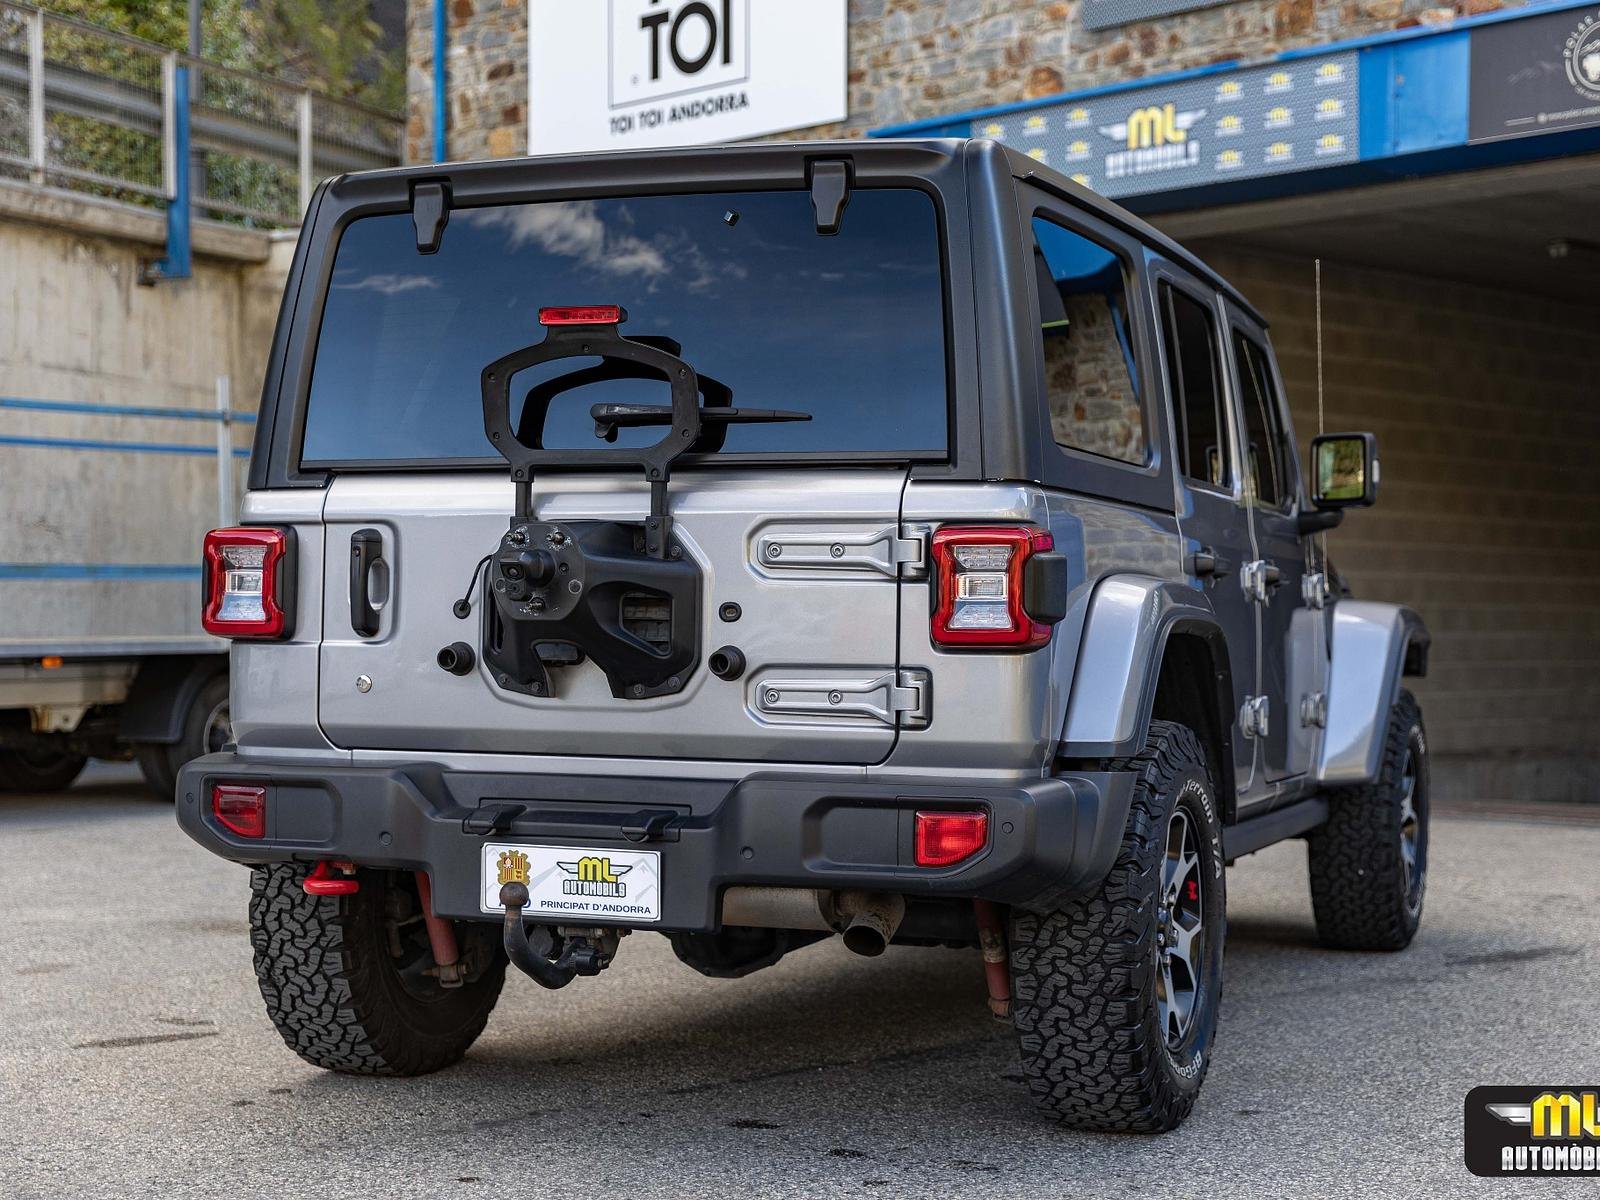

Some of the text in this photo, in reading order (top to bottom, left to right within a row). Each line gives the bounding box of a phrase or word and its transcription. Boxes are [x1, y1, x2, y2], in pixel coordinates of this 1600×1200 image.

[640, 0, 732, 80] TOI
[610, 92, 749, 134] TOI TOI ANDORRA
[1127, 103, 1187, 151] ML
[577, 857, 618, 883] ML
[540, 900, 590, 911] PRINCIPAT
[592, 903, 651, 914] D'ANDORRA
